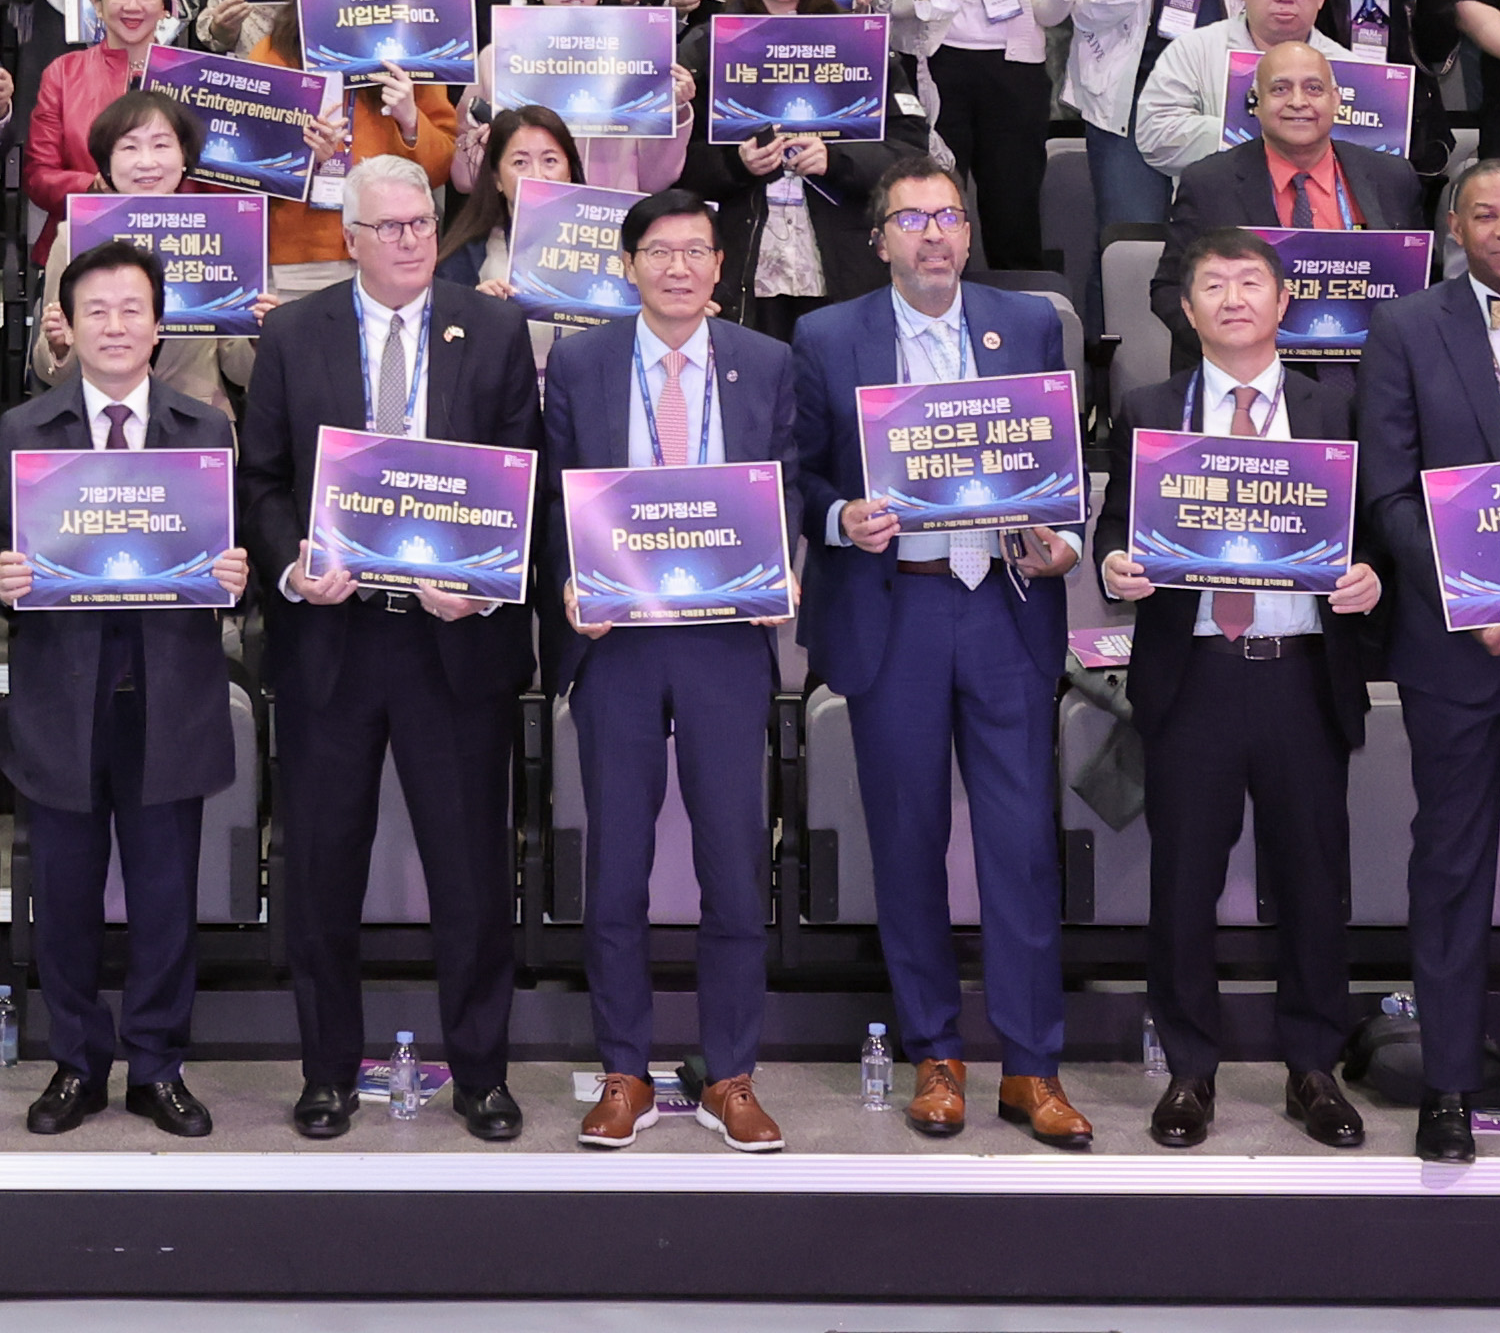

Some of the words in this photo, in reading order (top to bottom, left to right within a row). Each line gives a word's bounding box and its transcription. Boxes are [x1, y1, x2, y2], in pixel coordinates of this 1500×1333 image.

[765, 44, 837, 59] 기업가정신은
[725, 63, 758, 83] 나눔
[761, 63, 810, 84] 그리고
[813, 62, 873, 83] 성장이다.
[924, 397, 1012, 419] 기업가정신은
[888, 422, 980, 452] 열정으로
[985, 416, 1052, 445] 세상을
[906, 452, 975, 480] 밝히는
[980, 449, 1040, 474] 힘이다.
[1200, 453, 1290, 476] 기업가정신은
[79, 486, 166, 503] 기업가정신은
[380, 469, 467, 495] 기업가정신은
[1159, 473, 1229, 502] 실패를
[1236, 479, 1328, 507] 넘어서는
[327, 486, 395, 516] Future
[399, 494, 518, 529] Promise이다.
[630, 501, 718, 521] 기업가정신은
[1177, 504, 1307, 534] 도전정신이다.
[59, 509, 187, 534] 사업보국이다.
[613, 526, 742, 551] Passion이다.
